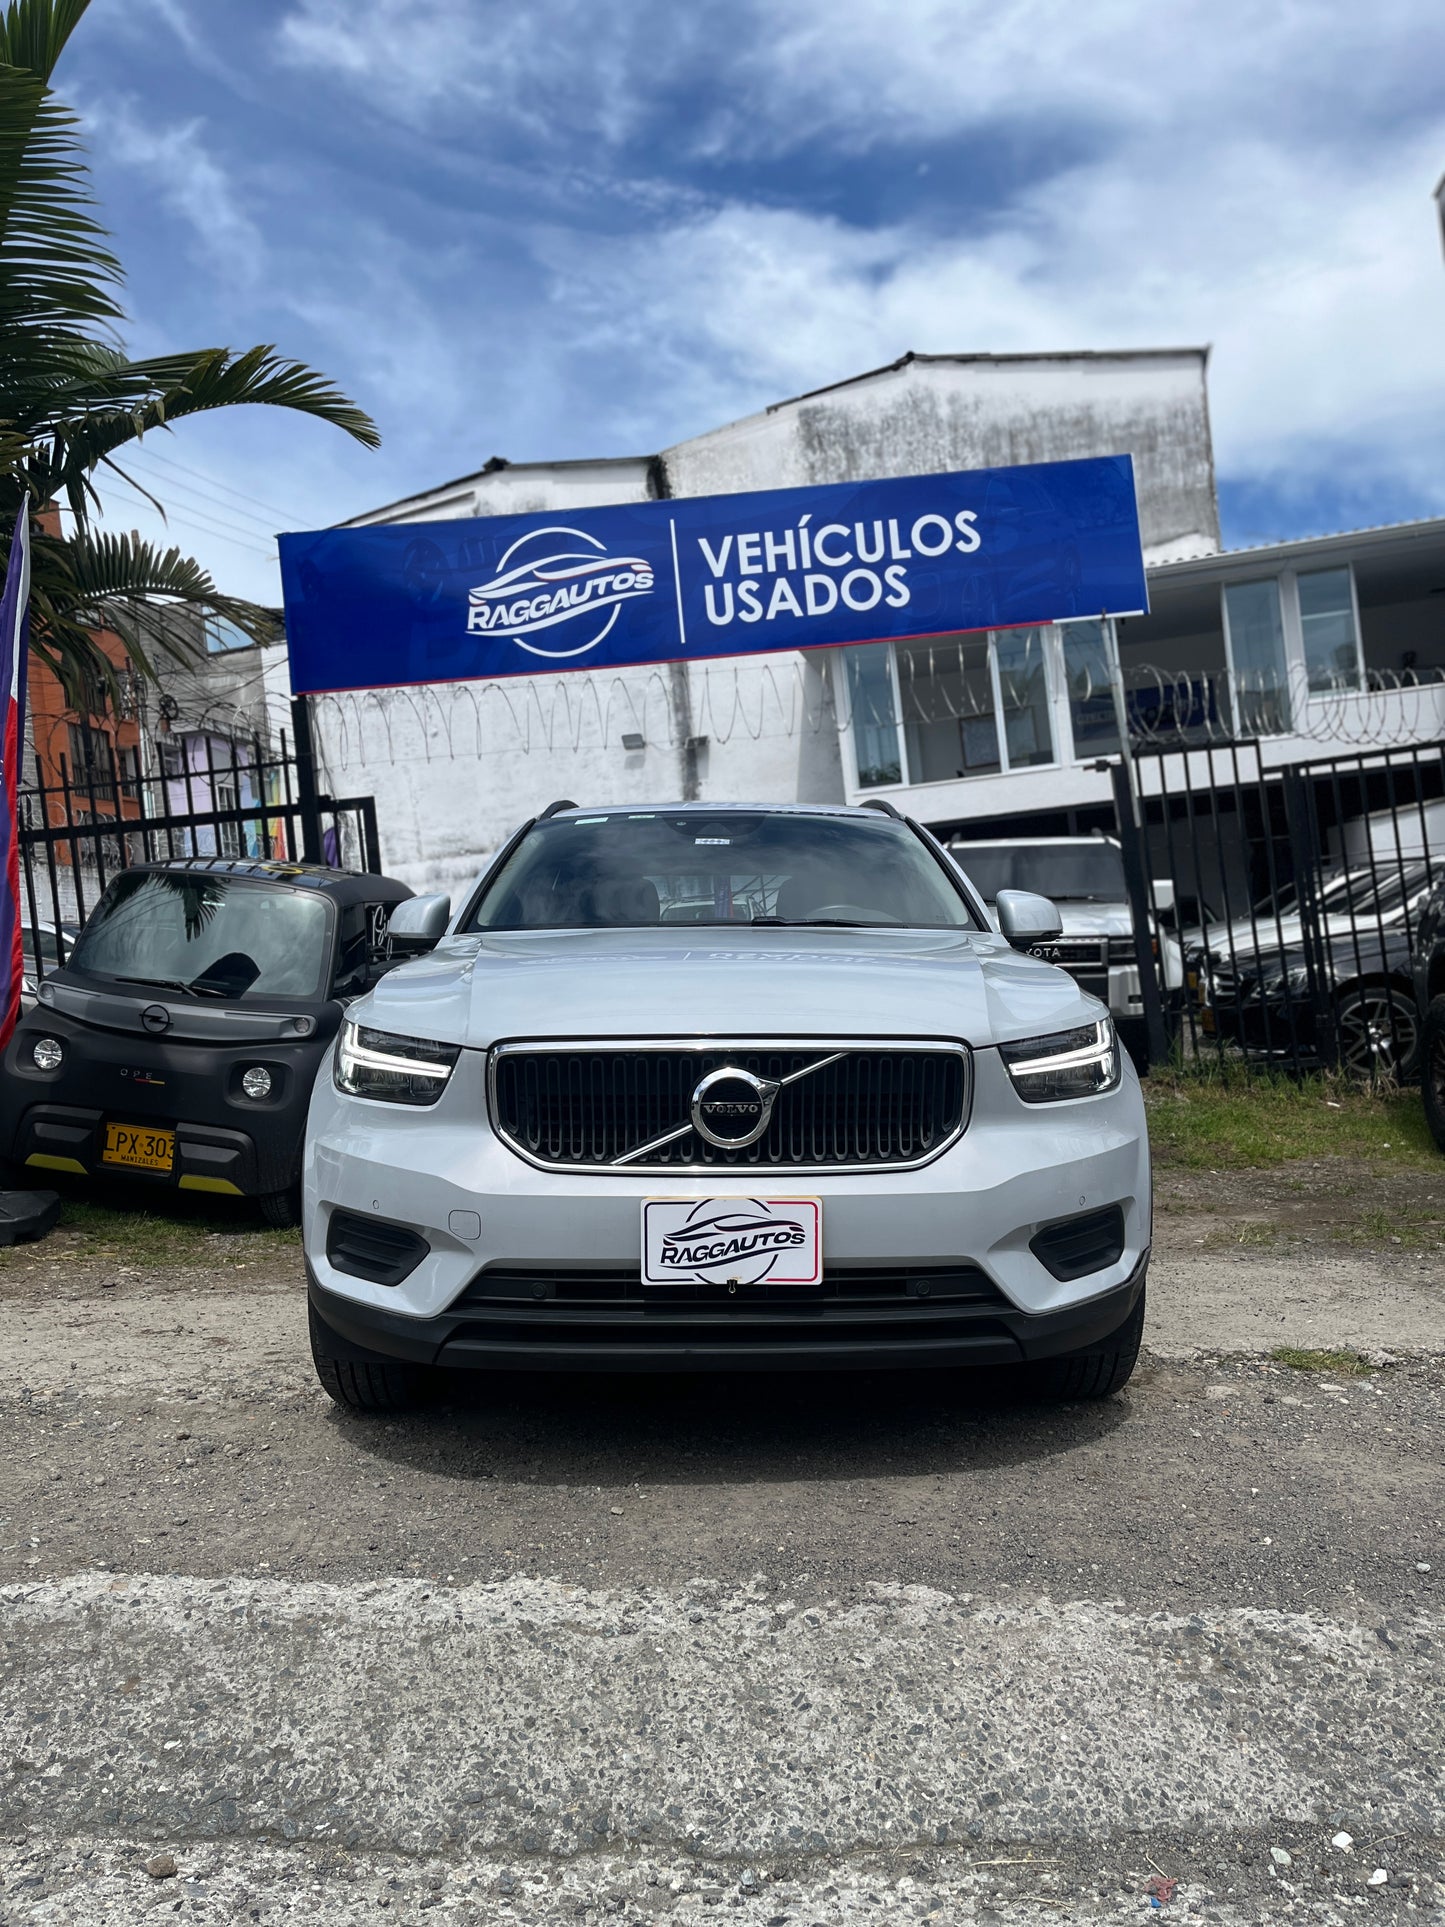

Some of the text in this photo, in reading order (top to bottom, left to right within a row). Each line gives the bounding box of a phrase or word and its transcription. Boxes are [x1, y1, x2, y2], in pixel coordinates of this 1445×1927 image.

[698, 510, 981, 578] VEHÍCULOS
[467, 572, 654, 630] RAGGAUTOS
[704, 565, 910, 625] USADOS
[1026, 947, 1061, 957] YOTA
[703, 1104, 759, 1113] VOLVO
[121, 1155, 159, 1166] MANIZALES
[660, 1231, 806, 1264] RAGGAUTOS
